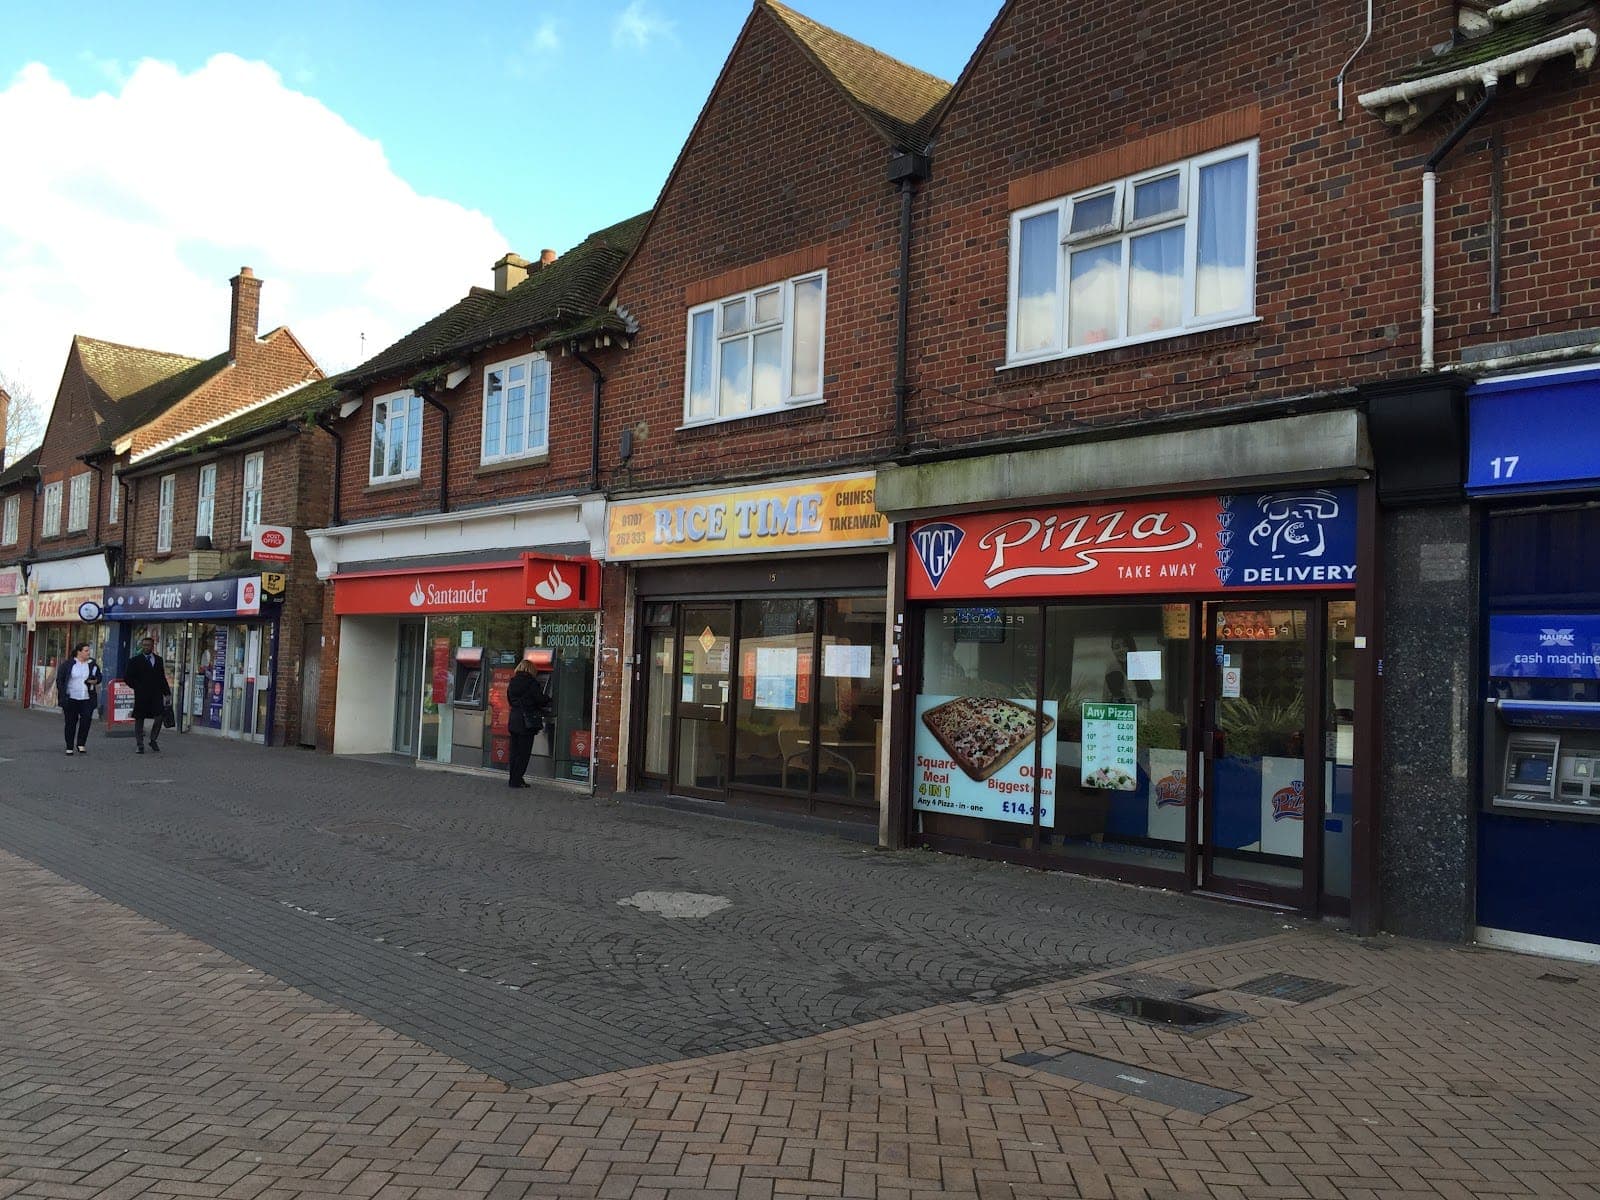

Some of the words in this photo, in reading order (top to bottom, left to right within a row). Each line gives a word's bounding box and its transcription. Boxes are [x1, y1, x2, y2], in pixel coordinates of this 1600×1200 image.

[1490, 455, 1519, 479] 17
[835, 489, 876, 507] CHINES
[654, 502, 727, 544] RICE
[735, 492, 823, 538] TIME
[829, 513, 882, 531] TAKEAWAY
[979, 510, 1186, 582] Pizza
[1118, 566, 1150, 579] TAKE
[1159, 563, 1197, 577] AWAY
[1244, 565, 1357, 582] DELIVERY
[148, 588, 182, 609] Martin's
[427, 580, 488, 605] Santander
[546, 635, 564, 646] 0800
[566, 635, 578, 646] 030
[1514, 652, 1542, 664] cash
[1547, 652, 1600, 664] machine
[1087, 706, 1105, 718] Any
[1108, 707, 1134, 718] Pizza
[917, 756, 957, 770] Square
[924, 771, 949, 784] Meal
[988, 778, 1030, 793] Biggest
[919, 784, 926, 795] 4
[928, 784, 941, 797] IN
[944, 786, 951, 798] 1
[918, 798, 930, 806] Any
[938, 800, 954, 808] Pizza
